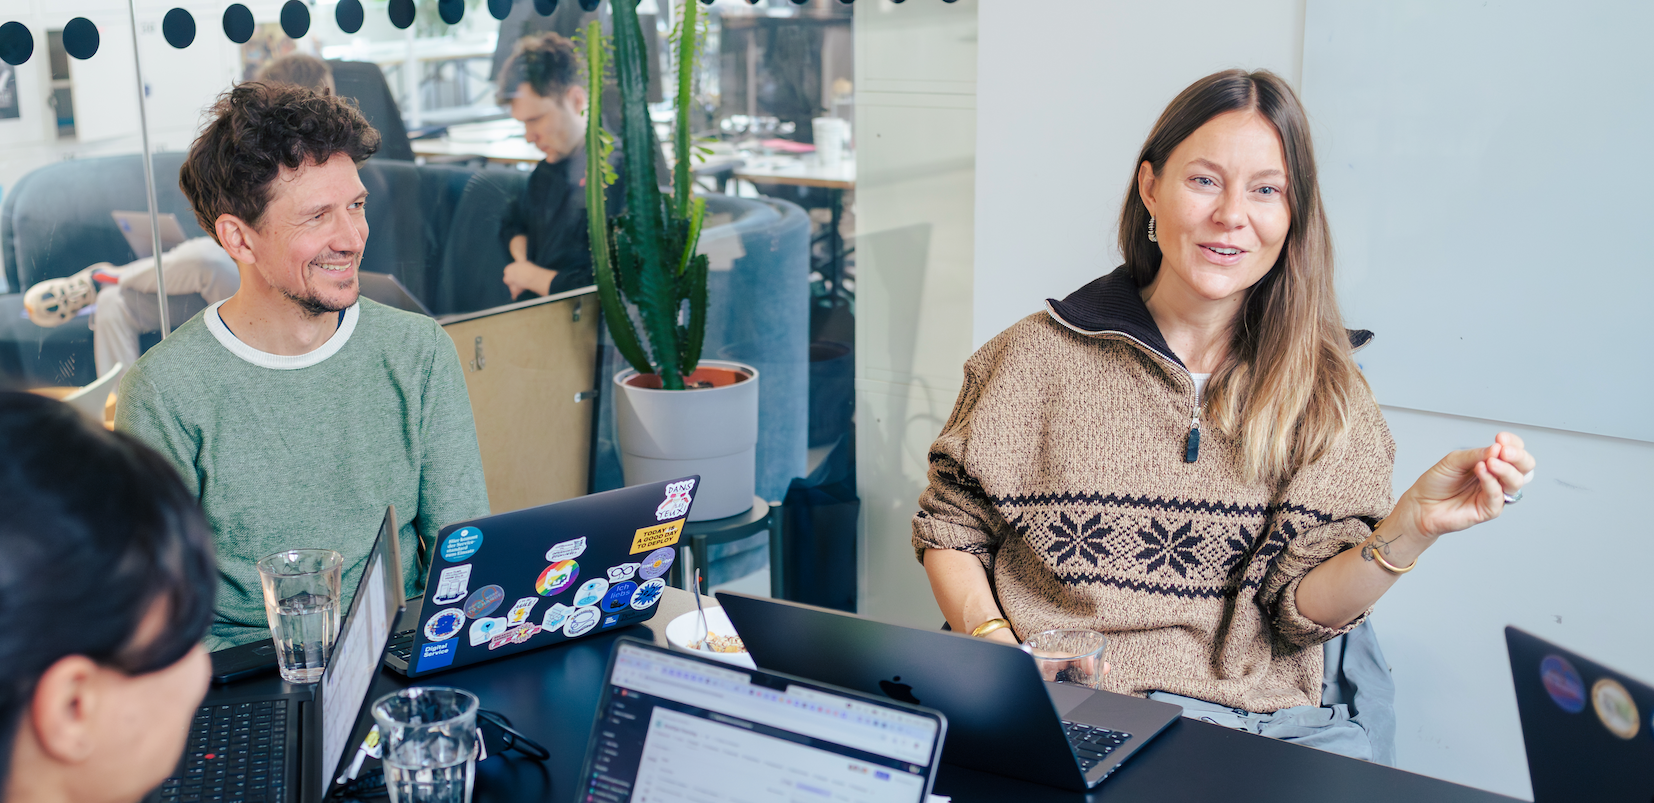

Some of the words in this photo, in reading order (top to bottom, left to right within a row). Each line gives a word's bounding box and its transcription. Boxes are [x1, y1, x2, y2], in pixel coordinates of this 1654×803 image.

[668, 482, 692, 494] DANS
[643, 527, 667, 537] TODAY
[643, 534, 664, 542] GOOD
[664, 529, 679, 538] DAY
[647, 536, 675, 547] DEPLOY
[424, 643, 448, 652] Digital
[423, 649, 449, 658] Service
